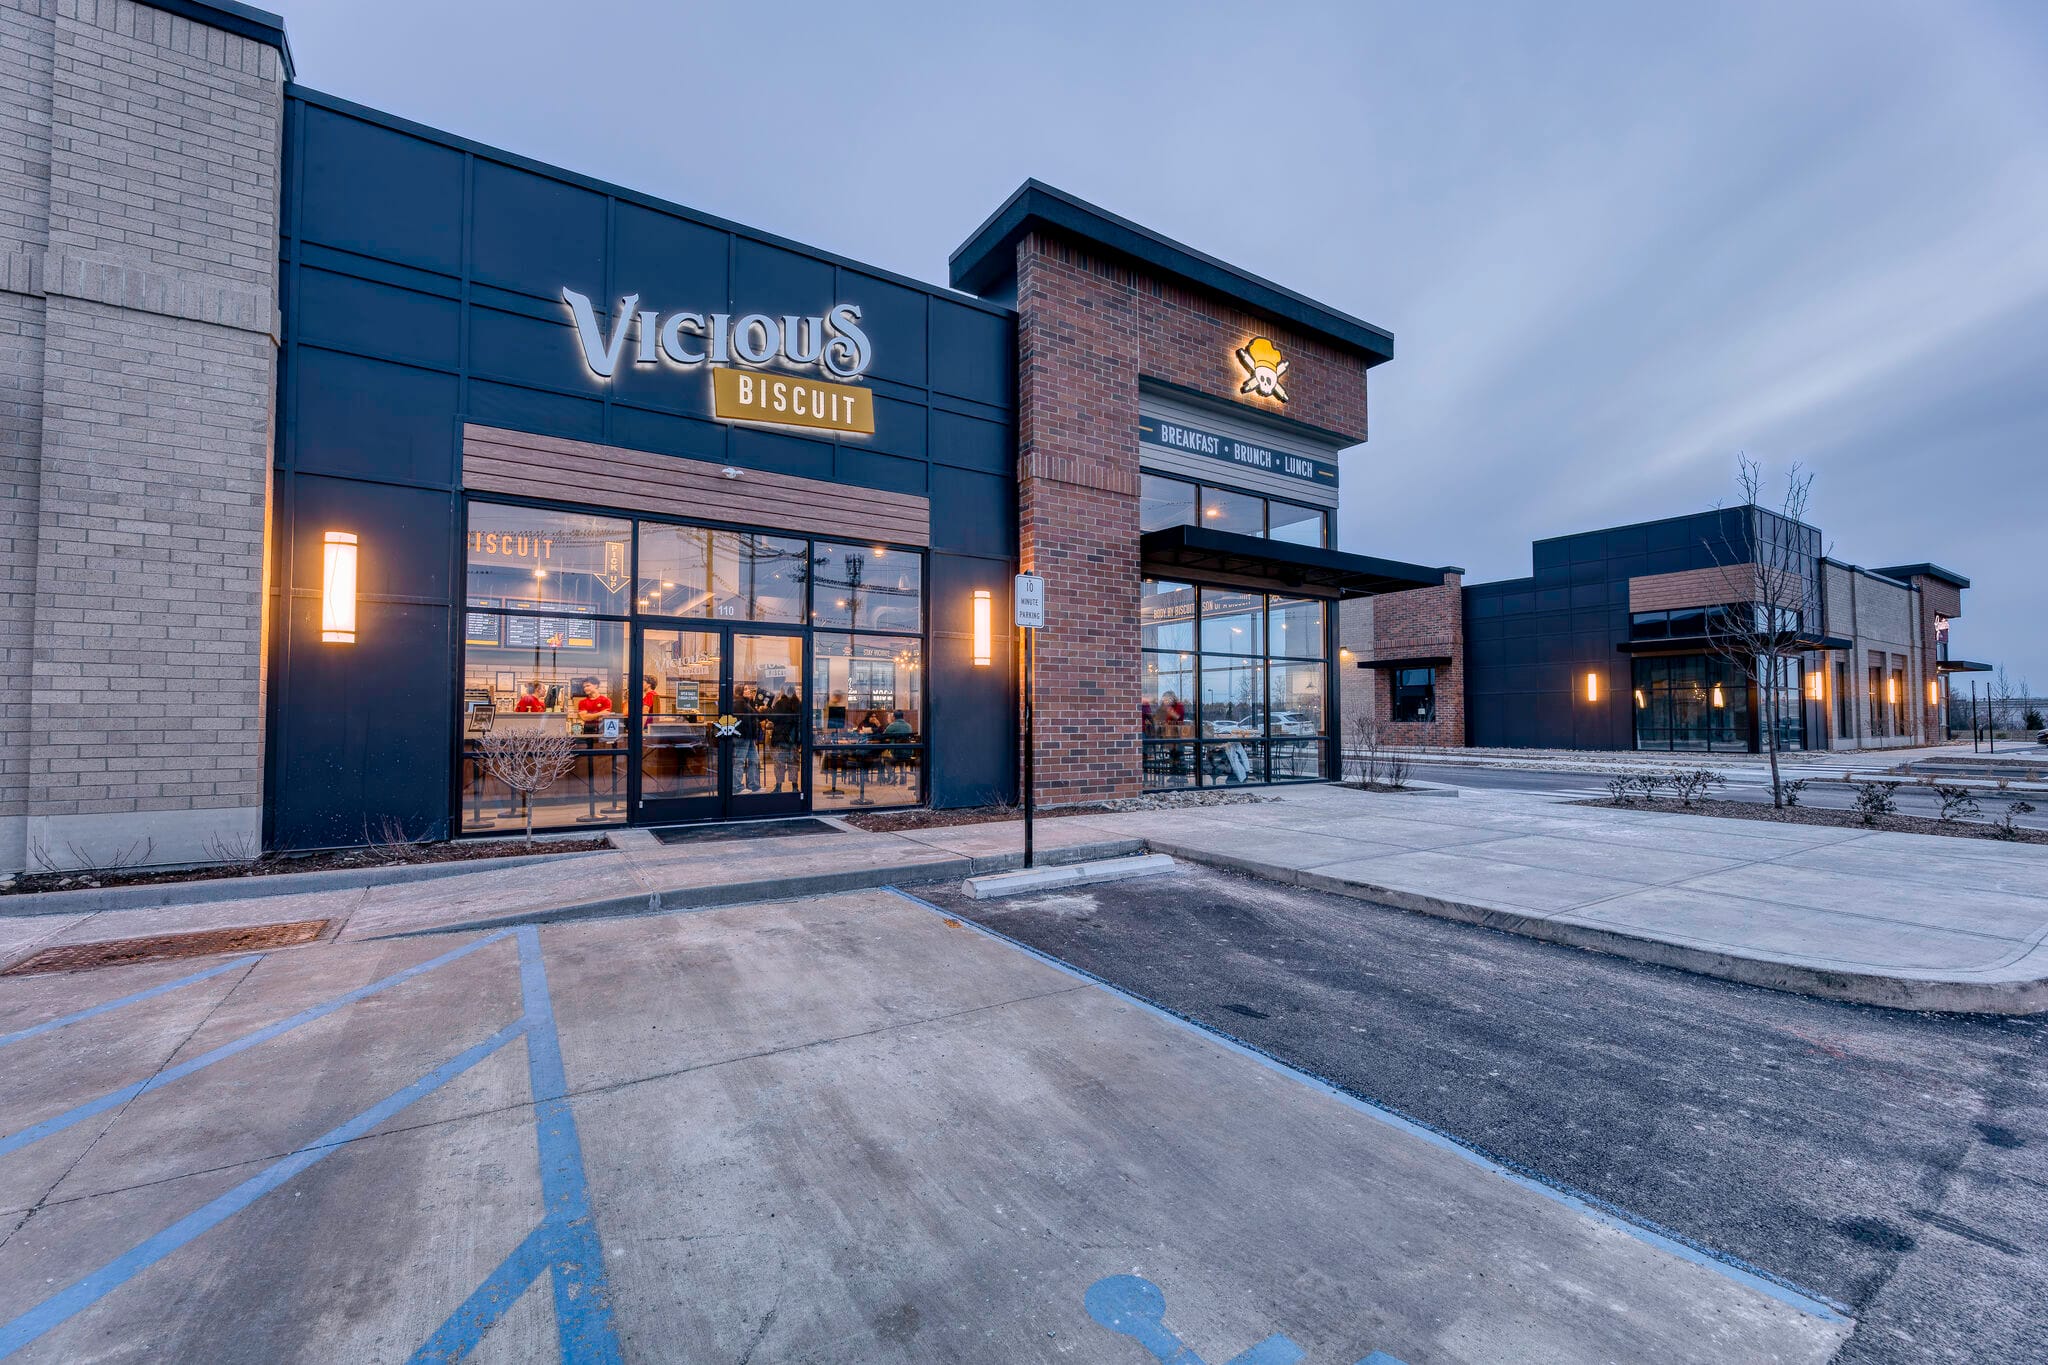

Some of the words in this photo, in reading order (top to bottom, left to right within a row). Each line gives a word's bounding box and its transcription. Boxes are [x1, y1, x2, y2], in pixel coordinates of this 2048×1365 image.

[562, 286, 872, 377] VICIOUS
[738, 374, 855, 424] BISCUIT
[1161, 424, 1219, 455] BREAKFAST
[1234, 443, 1271, 468] BRUNCH
[1284, 456, 1313, 478] LUNCH
[467, 532, 553, 559] ISCUIT
[610, 545, 618, 571] PICK
[610, 575, 617, 588] UP
[1026, 582, 1034, 592] 10
[1021, 598, 1039, 606] MINUTE
[718, 605, 734, 616] 110
[1019, 611, 1040, 619] PARKING
[607, 721, 616, 730] A
